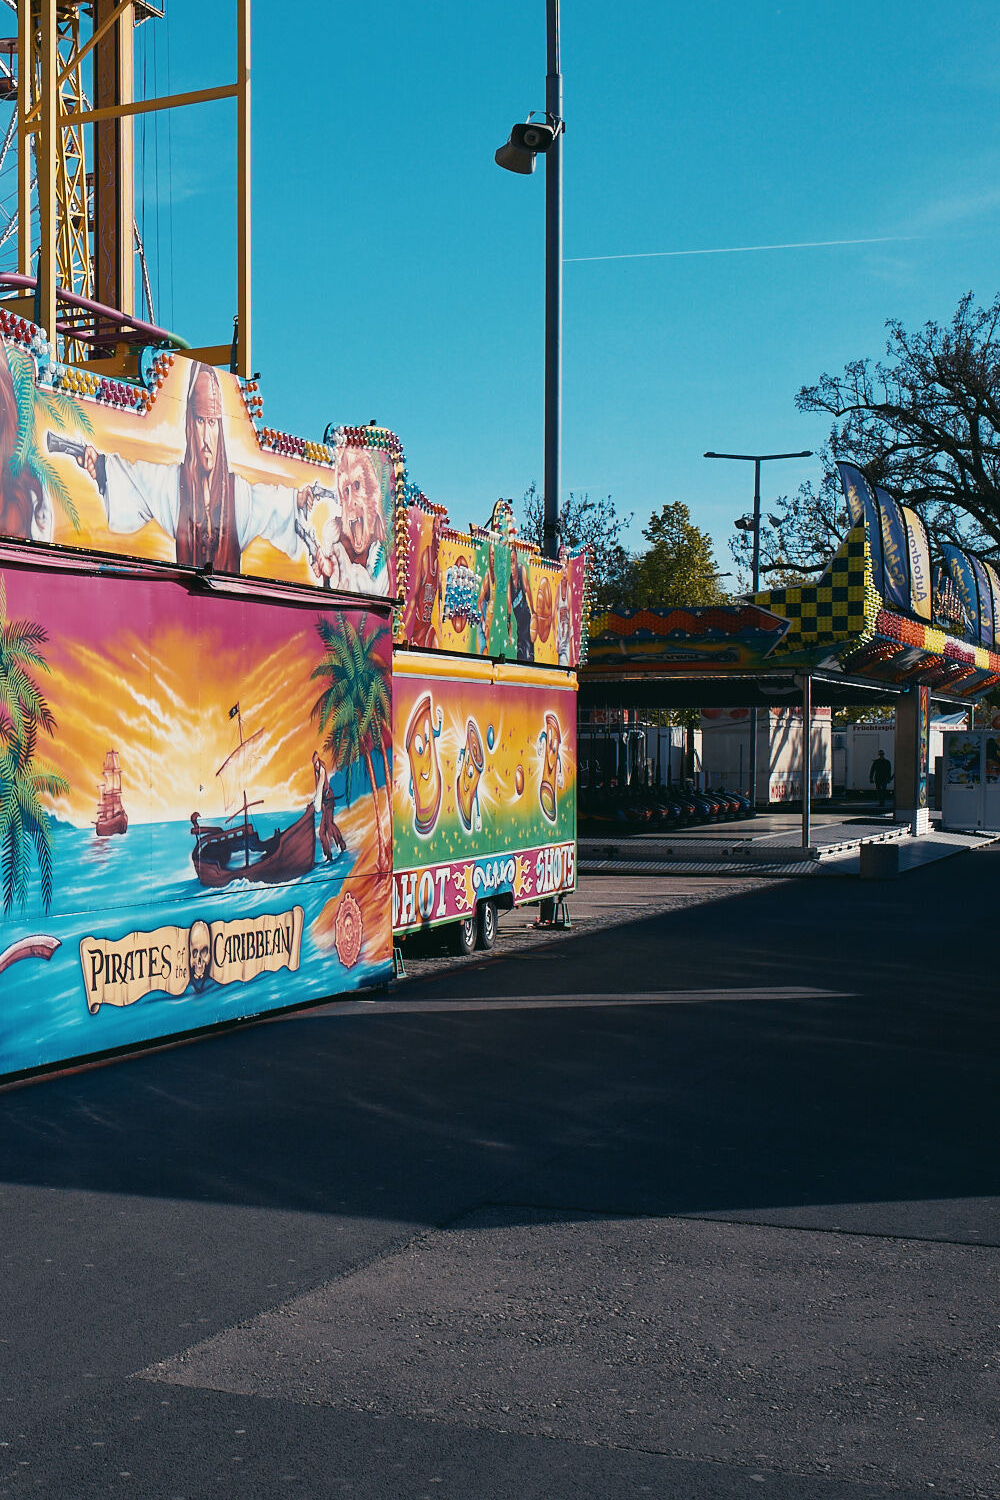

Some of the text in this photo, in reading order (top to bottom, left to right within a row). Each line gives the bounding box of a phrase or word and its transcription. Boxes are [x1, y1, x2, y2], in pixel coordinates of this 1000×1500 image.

[400, 844, 574, 924] HOT SHOTS
[88, 944, 186, 992] PIRATES of
[213, 923, 292, 968] CARIBBEAN
[175, 965, 188, 979] the
